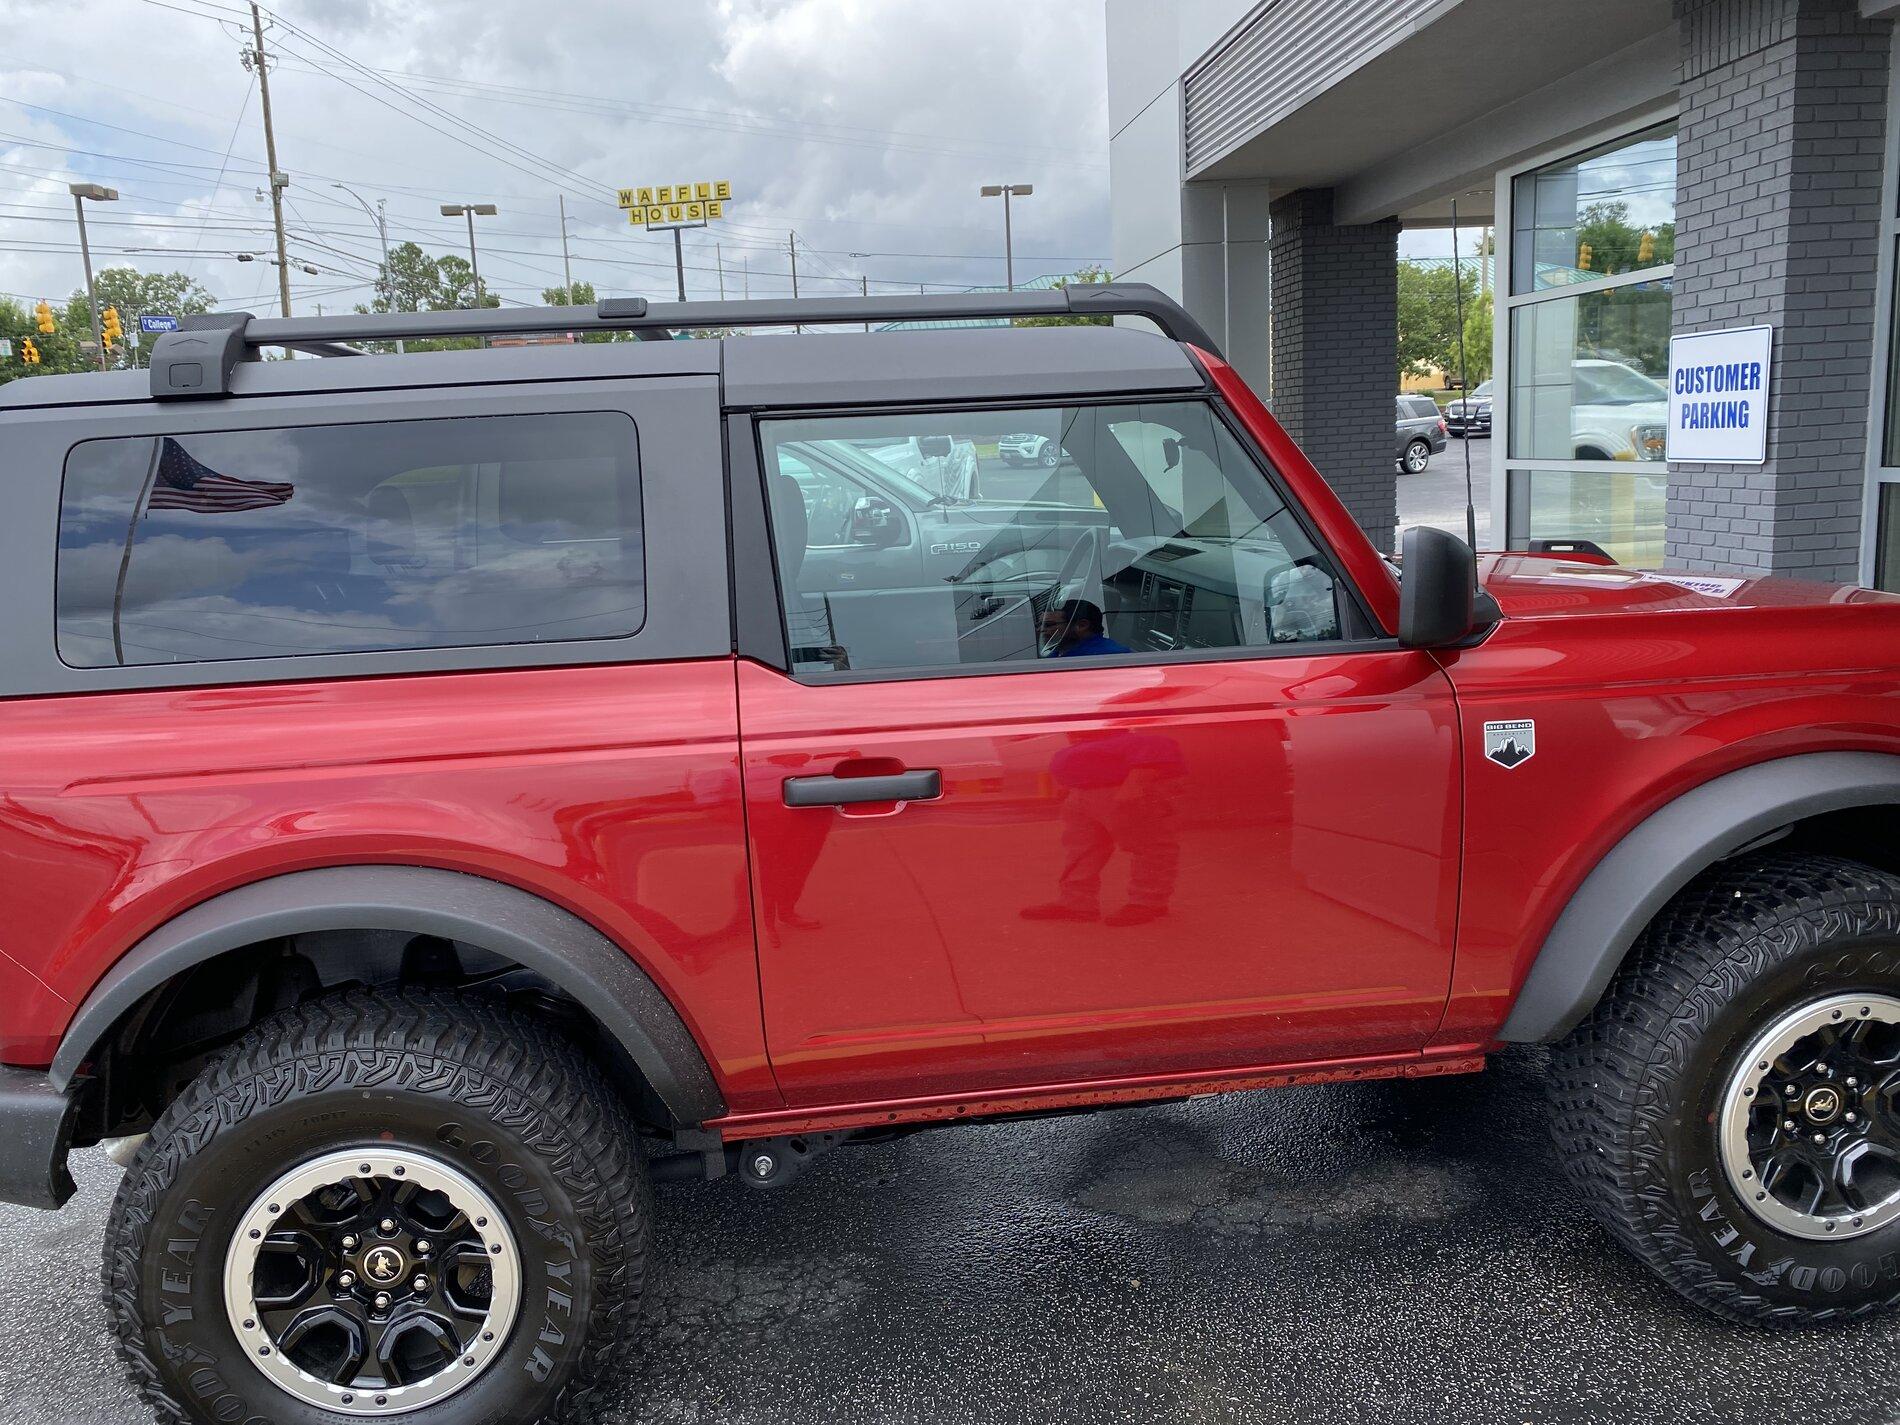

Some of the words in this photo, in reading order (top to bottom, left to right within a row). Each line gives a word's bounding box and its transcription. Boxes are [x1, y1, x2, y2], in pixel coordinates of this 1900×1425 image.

[619, 183, 728, 204] WAFFLE
[631, 203, 719, 223] HOUSE
[148, 319, 172, 329] College
[1674, 361, 1761, 395] CUSTOMER
[1680, 400, 1750, 430] PARKING
